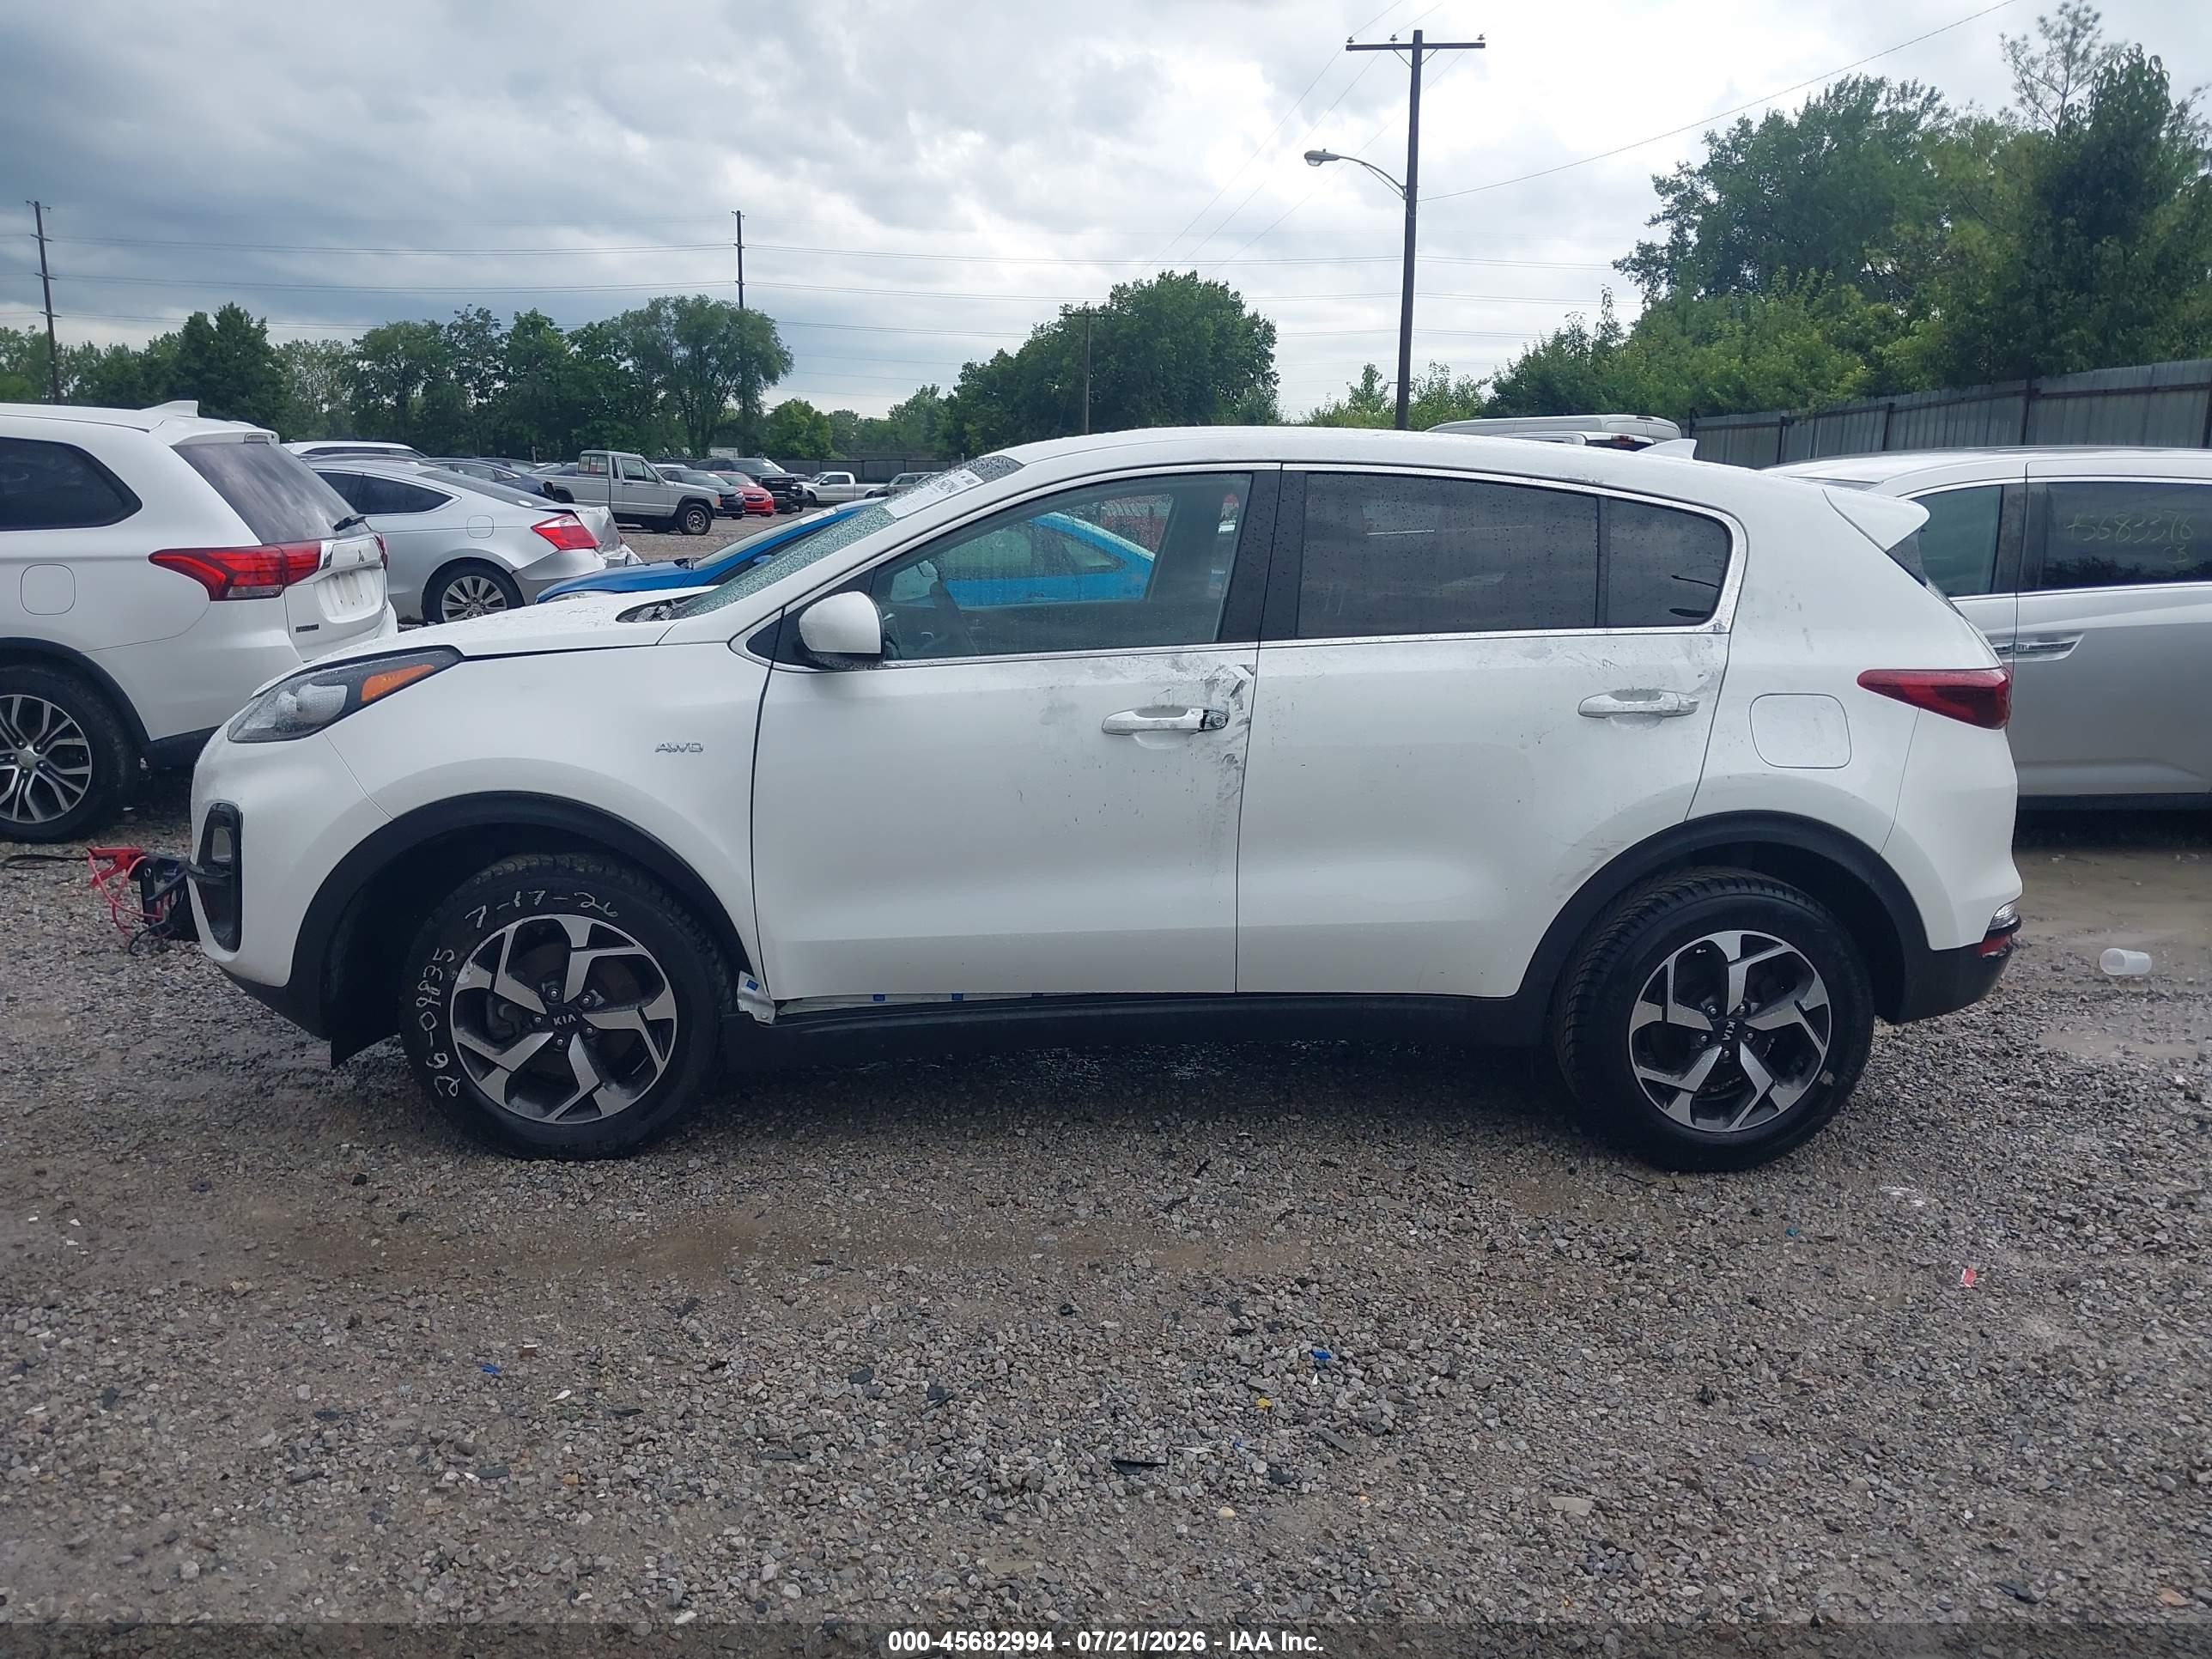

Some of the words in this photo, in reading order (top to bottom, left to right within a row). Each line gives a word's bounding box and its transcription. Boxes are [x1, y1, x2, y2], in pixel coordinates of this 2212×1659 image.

[654, 742, 703, 753] AWD
[553, 1013, 577, 1026] KIA
[1721, 1021, 1736, 1041] KIA
